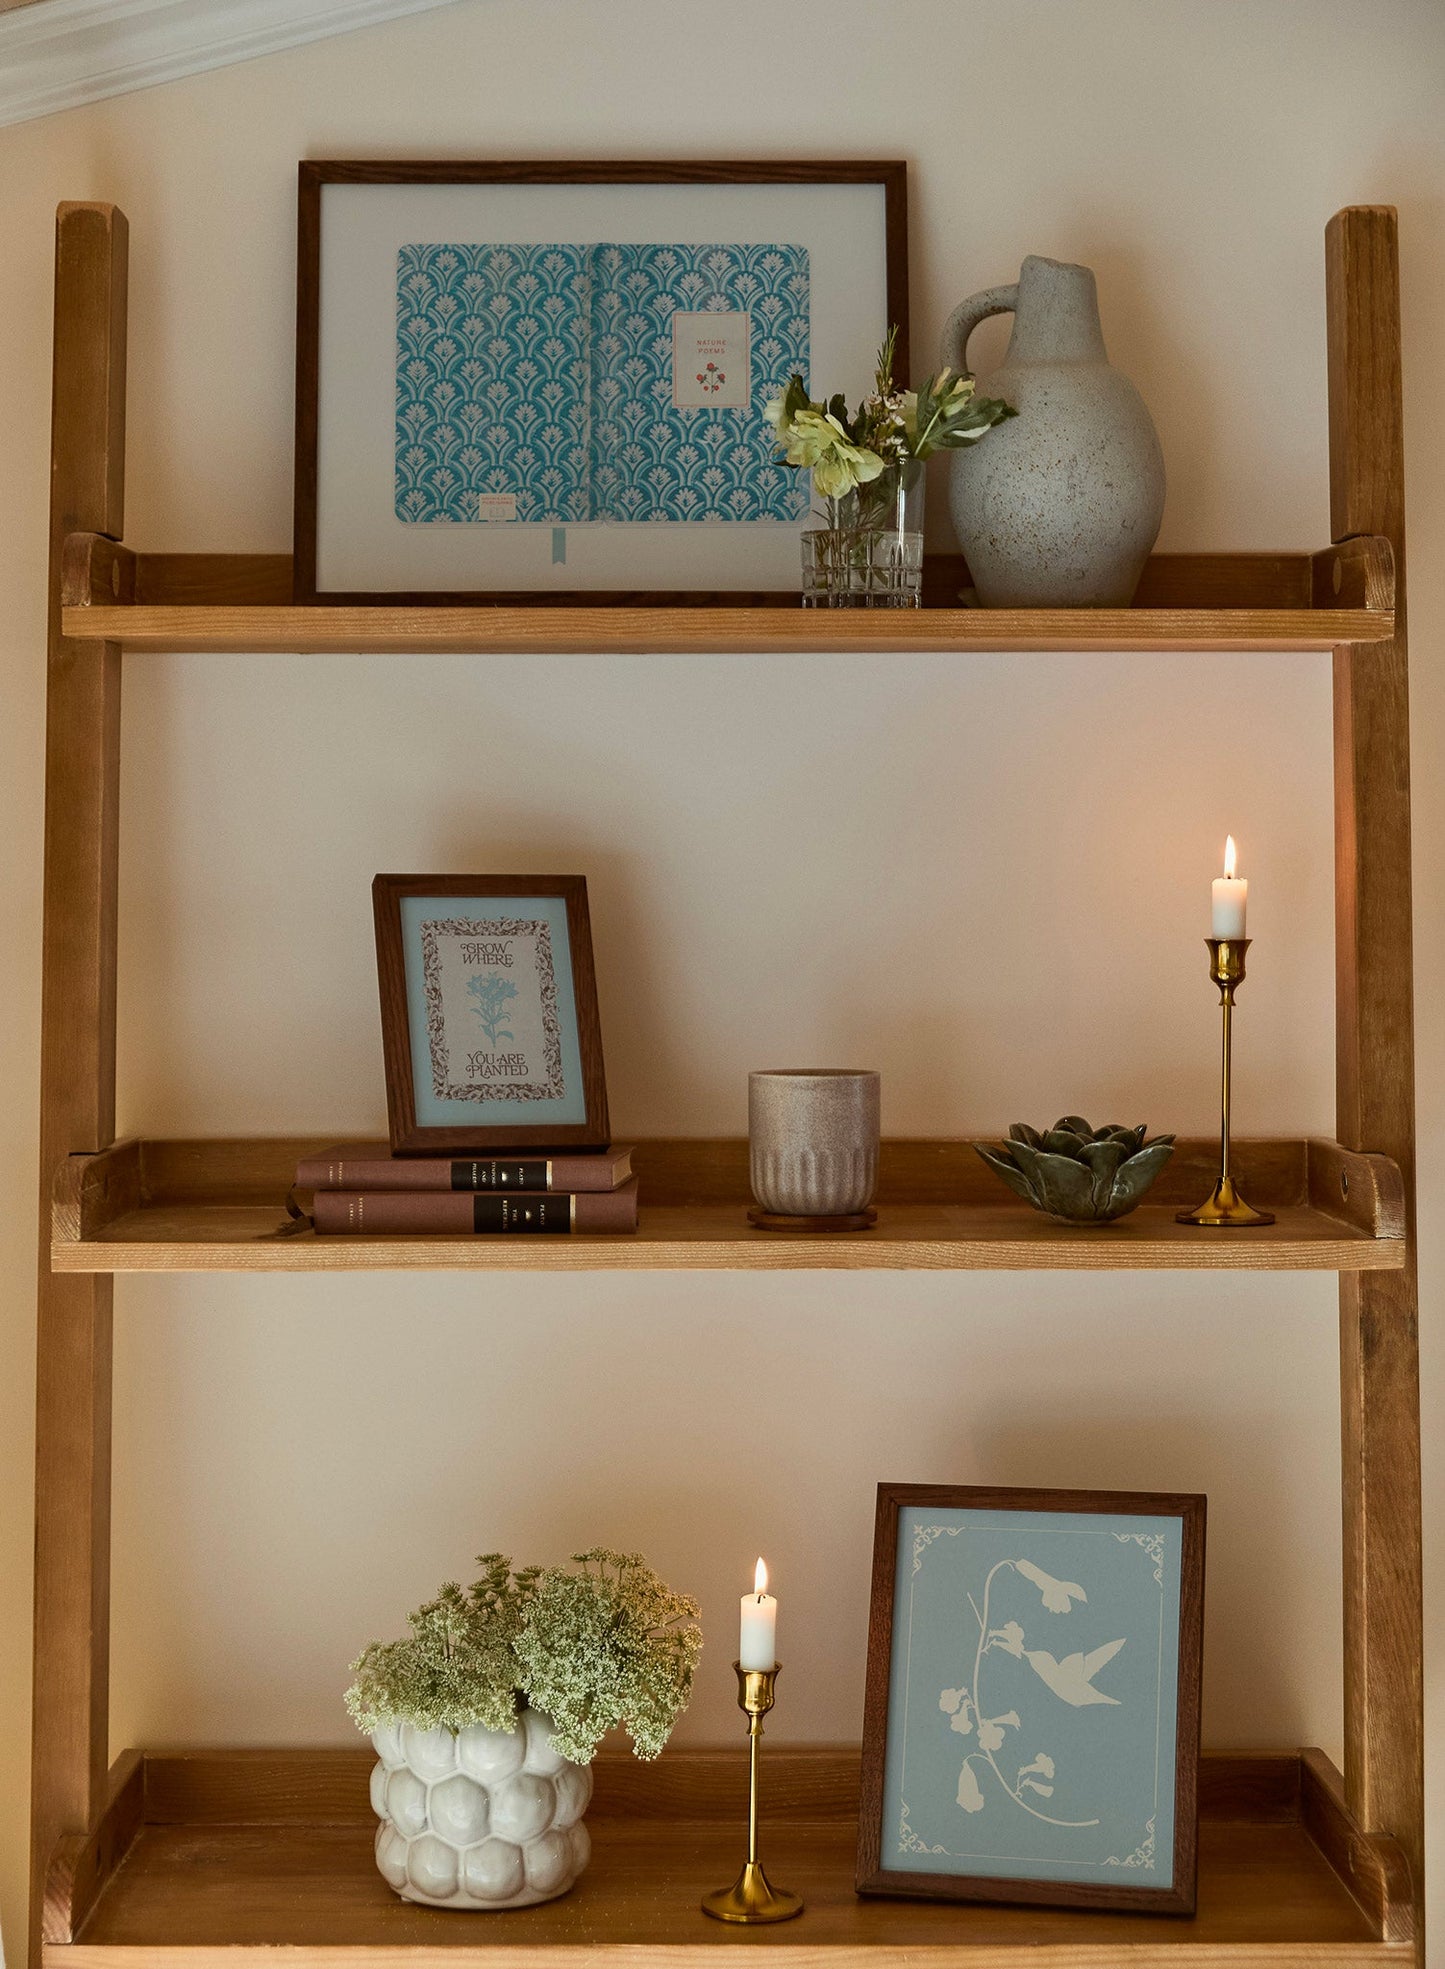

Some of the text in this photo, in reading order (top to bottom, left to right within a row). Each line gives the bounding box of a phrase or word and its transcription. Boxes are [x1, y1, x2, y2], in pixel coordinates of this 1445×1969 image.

[460, 940, 513, 954] GROW
[462, 954, 514, 967] WHERE
[467, 1050, 526, 1065] YOU ARE
[465, 1064, 529, 1079] PLANTED
